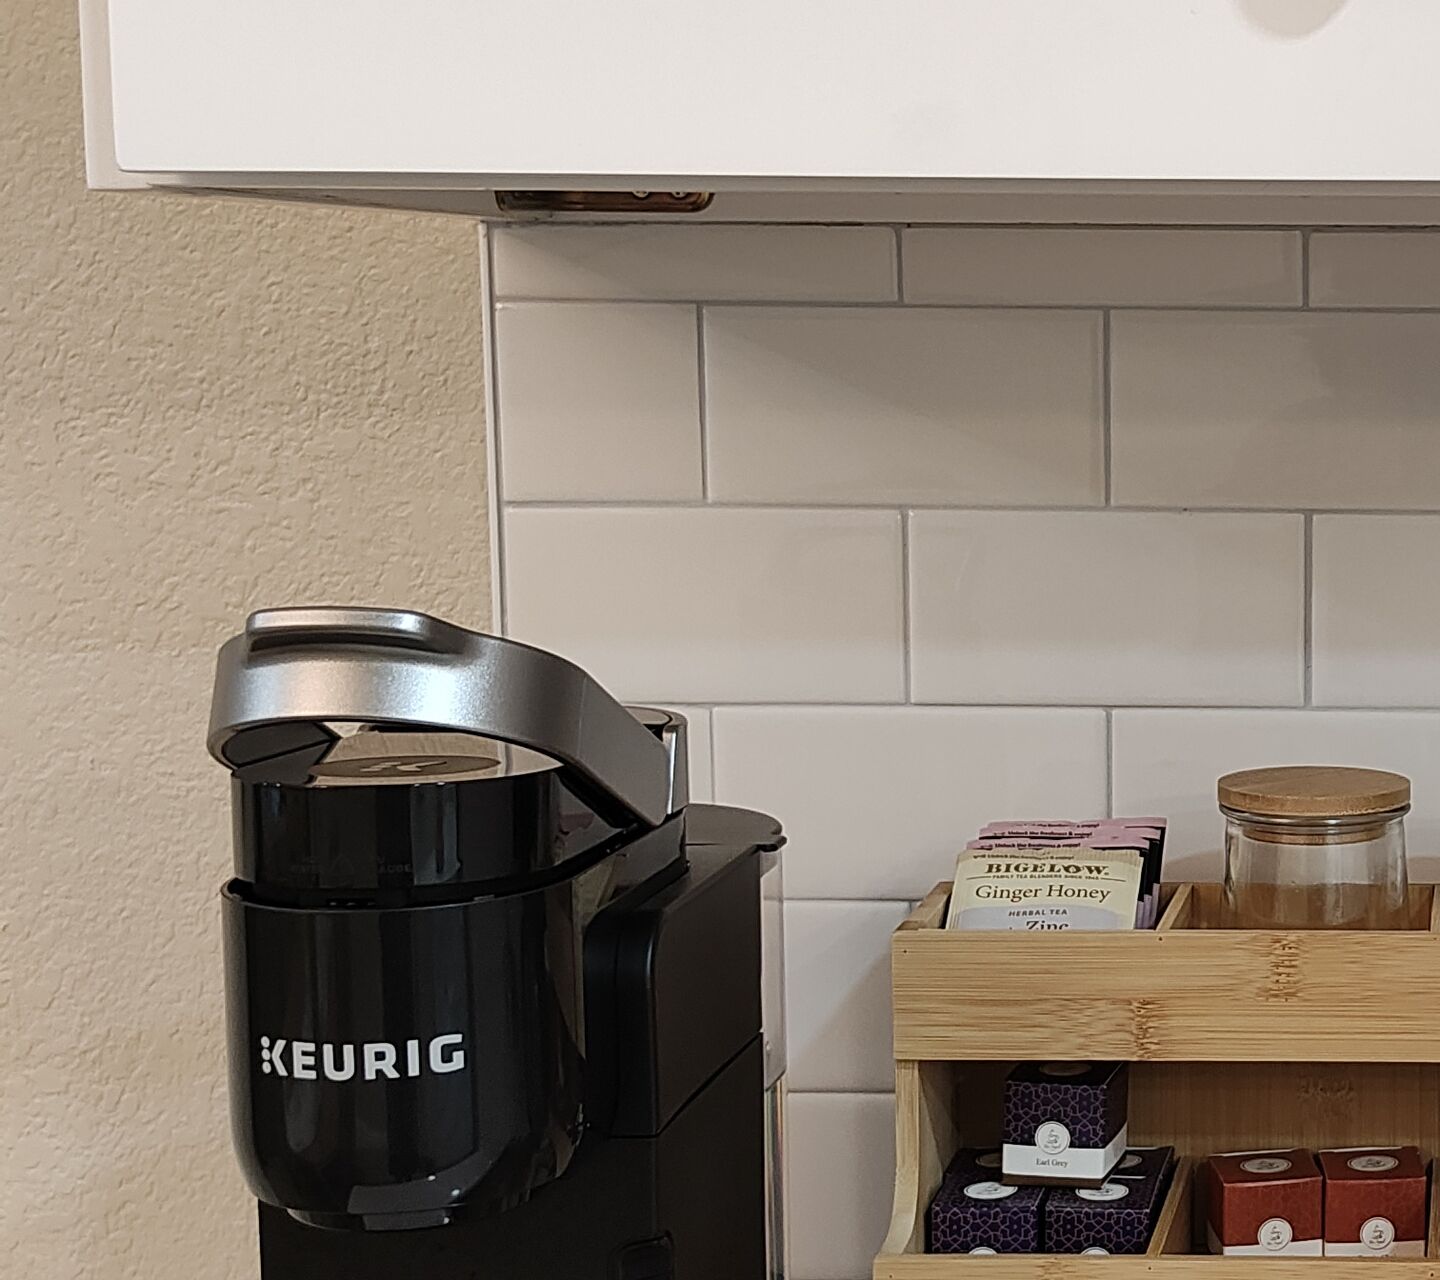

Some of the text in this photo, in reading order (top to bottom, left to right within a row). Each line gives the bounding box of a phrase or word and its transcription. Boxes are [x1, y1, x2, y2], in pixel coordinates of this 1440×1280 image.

[975, 884, 1112, 903] Ginger Honey
[1008, 908, 1068, 917] HERBAL TEA
[260, 1033, 465, 1081] KEURIG
[1036, 1158, 1069, 1168] Earl Grey
